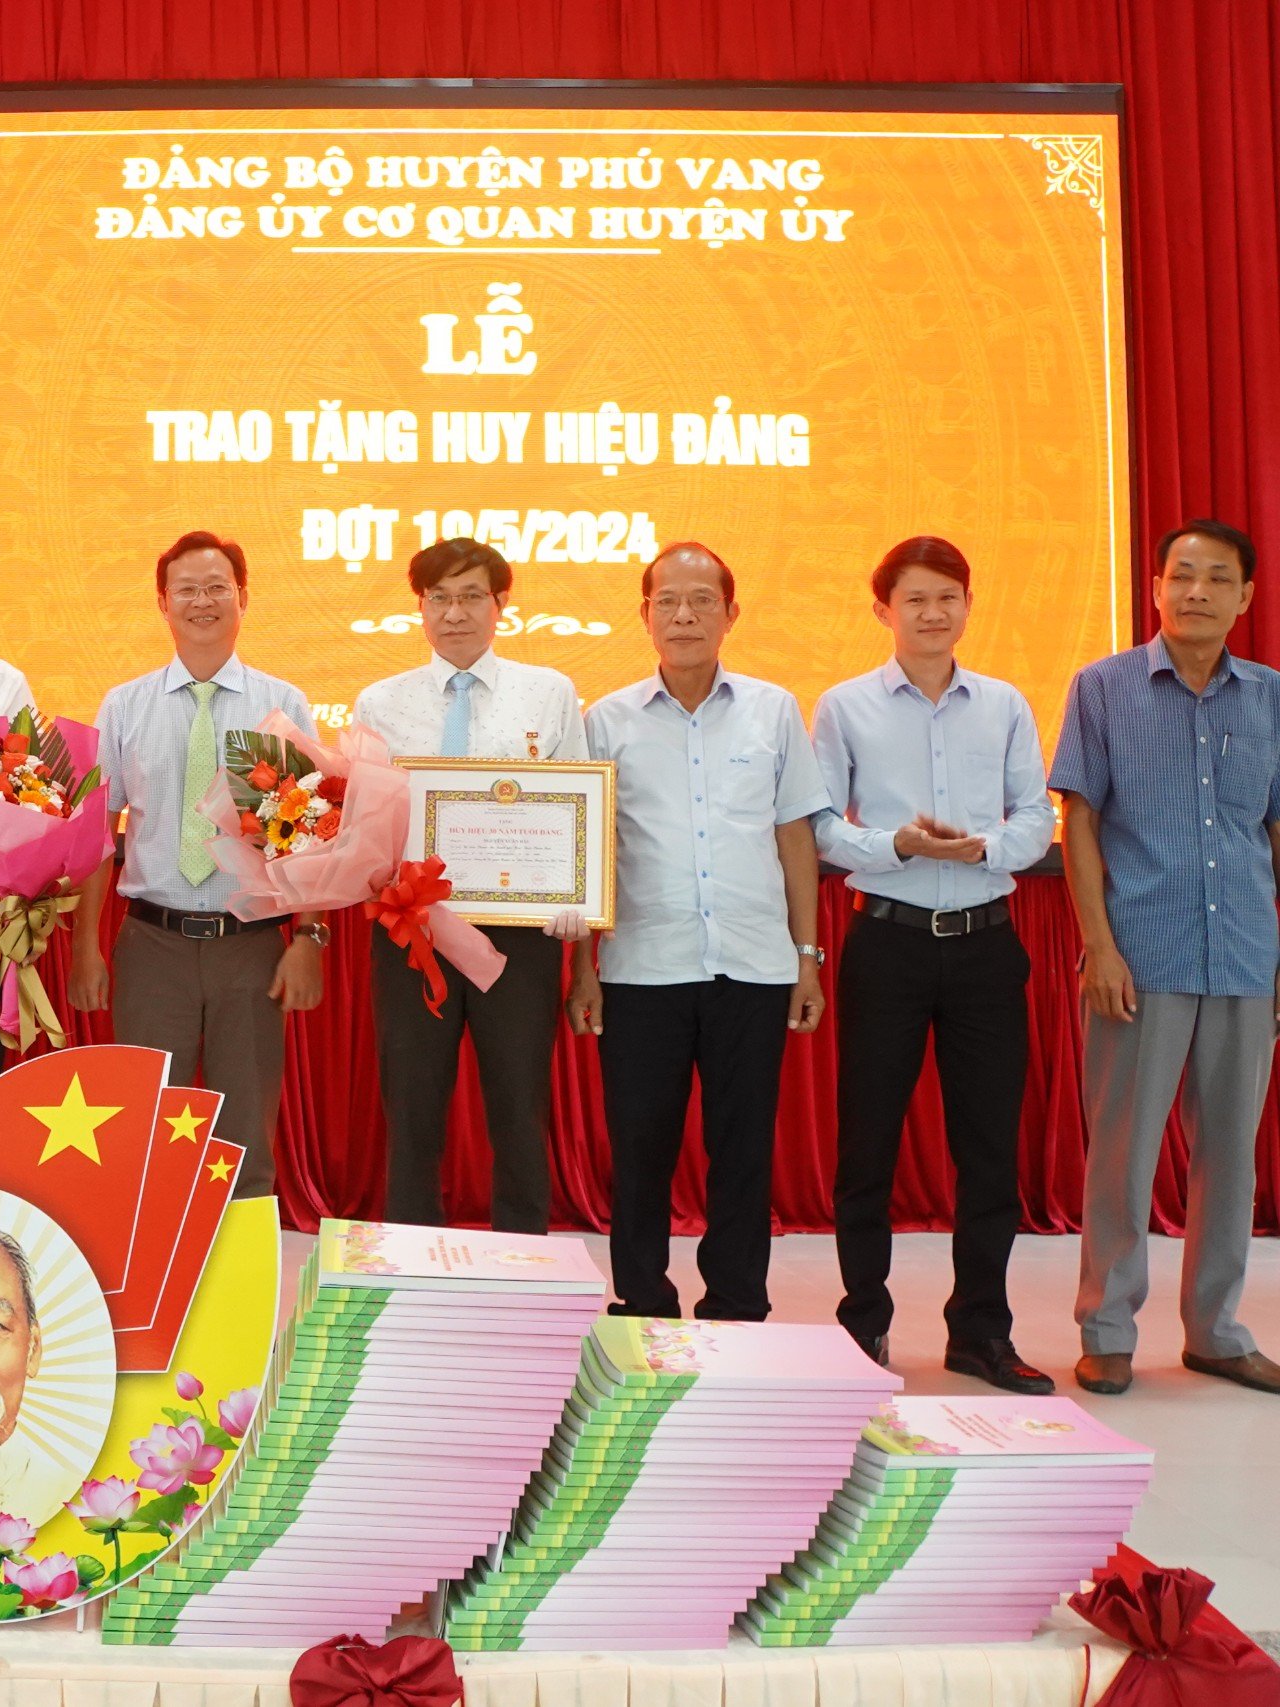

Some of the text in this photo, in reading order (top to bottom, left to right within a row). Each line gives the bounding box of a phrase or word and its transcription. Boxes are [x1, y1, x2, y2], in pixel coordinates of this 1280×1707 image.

[122, 144, 824, 197] ĐẢNG BỘ HUYỆN PHÚ VANG
[95, 192, 853, 249] ĐẢNG ỦY CƠ QUAN HUYỆN ỦY
[419, 281, 538, 376] LỄ
[146, 395, 811, 476] TRAO TẶNG HUY HIỆU ĐẢNG
[299, 503, 400, 573] ĐỢT
